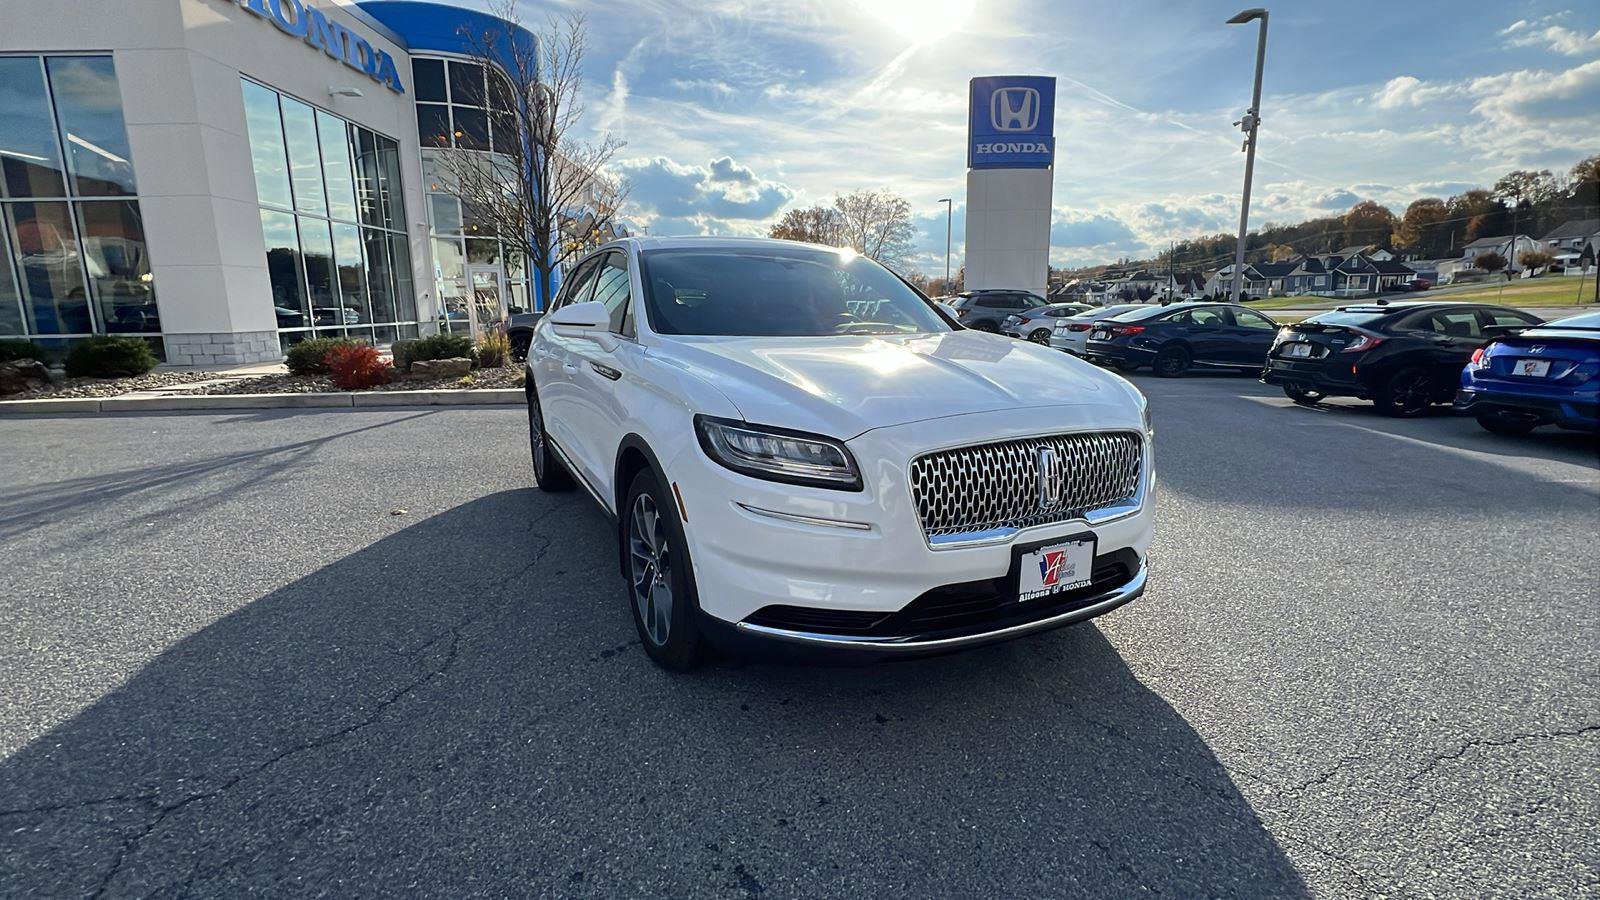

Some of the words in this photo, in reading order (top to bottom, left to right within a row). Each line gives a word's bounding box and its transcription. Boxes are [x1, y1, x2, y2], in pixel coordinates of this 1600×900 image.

[976, 142, 1049, 154] HONDA
[1018, 590, 1050, 602] Altoona
[1062, 580, 1092, 592] HONDA
